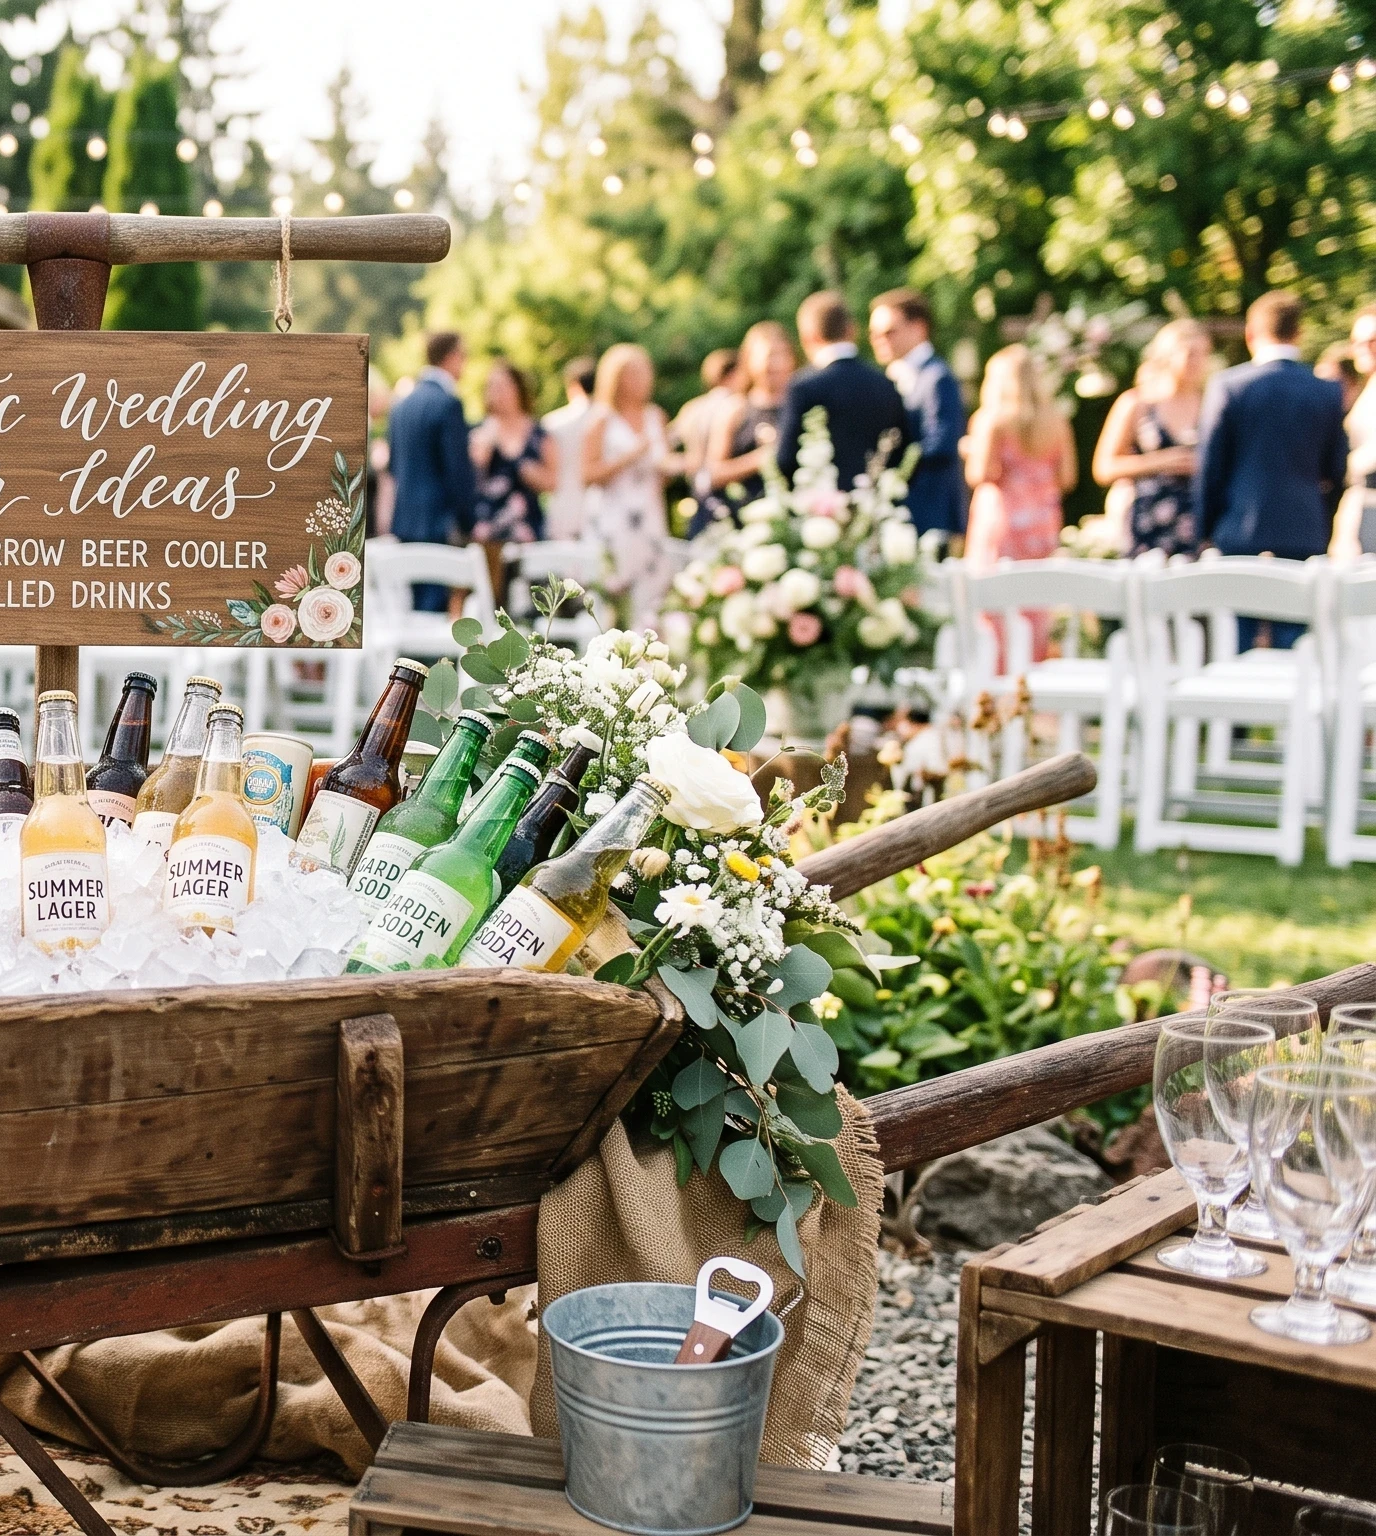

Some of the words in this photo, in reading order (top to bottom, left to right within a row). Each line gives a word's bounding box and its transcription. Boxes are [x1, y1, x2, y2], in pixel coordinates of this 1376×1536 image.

[51, 360, 333, 472] Wedding
[43, 444, 276, 520] Ideas
[81, 539, 149, 568] BEER
[164, 540, 268, 569] COOLER
[72, 580, 172, 610] DRINKS
[168, 858, 243, 883] SUMMER
[357, 857, 408, 884] GARD
[28, 878, 104, 900] SUMMER
[172, 878, 229, 899] LAGER
[354, 876, 392, 901] SOD
[37, 900, 97, 921] LAGER
[377, 913, 425, 949] SODA
[475, 926, 517, 965] SODA
